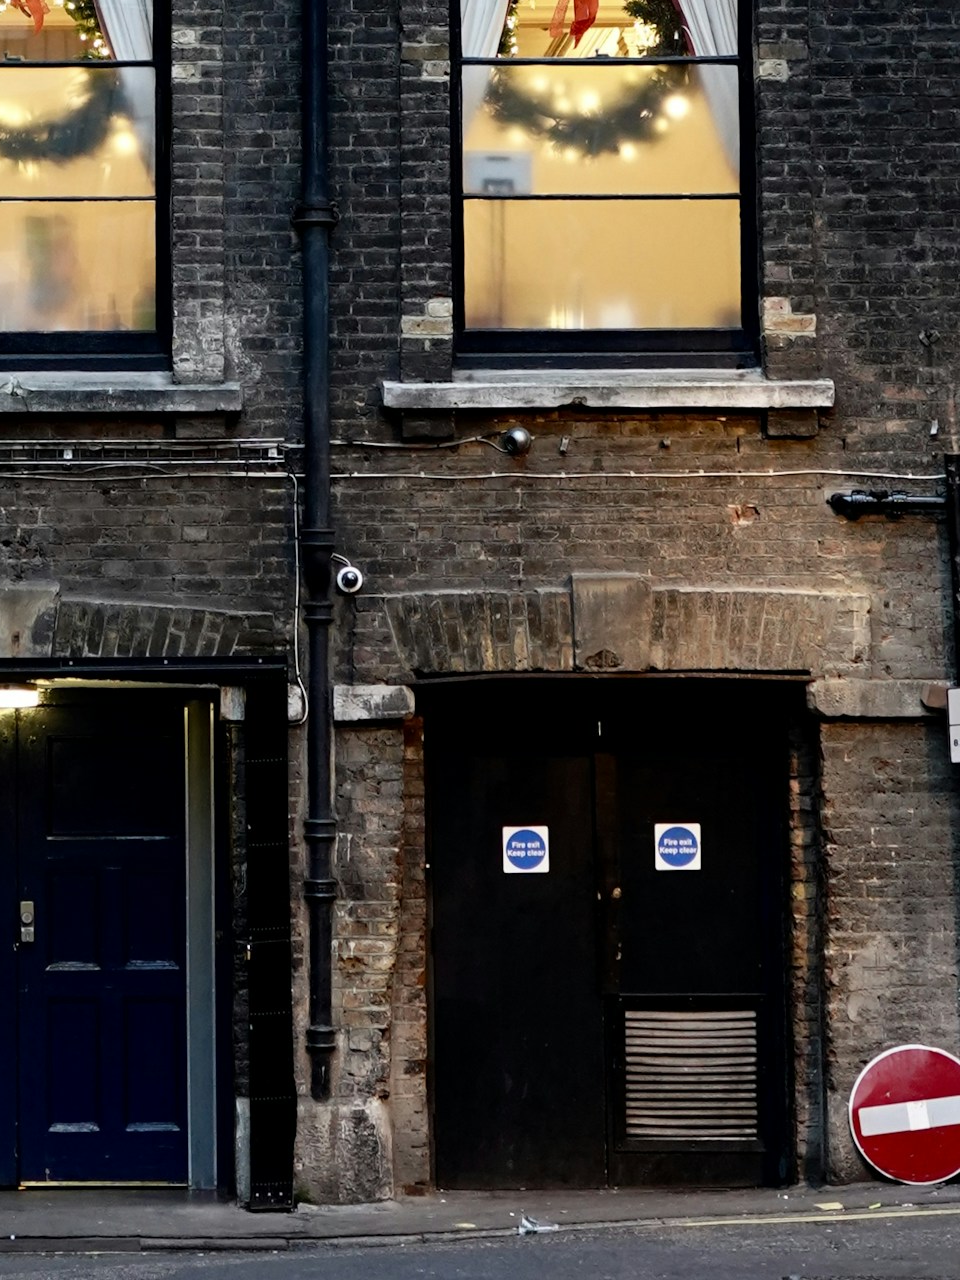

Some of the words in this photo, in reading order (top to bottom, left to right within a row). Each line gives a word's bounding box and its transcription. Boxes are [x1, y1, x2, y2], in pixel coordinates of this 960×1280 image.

[511, 841, 526, 849] Fire
[527, 841, 540, 849] exit
[663, 838, 678, 846] Fire
[679, 838, 693, 846] exit
[507, 849, 526, 858] Keep
[527, 849, 545, 857] clear
[659, 846, 678, 856] Keep
[679, 846, 698, 855] clear
